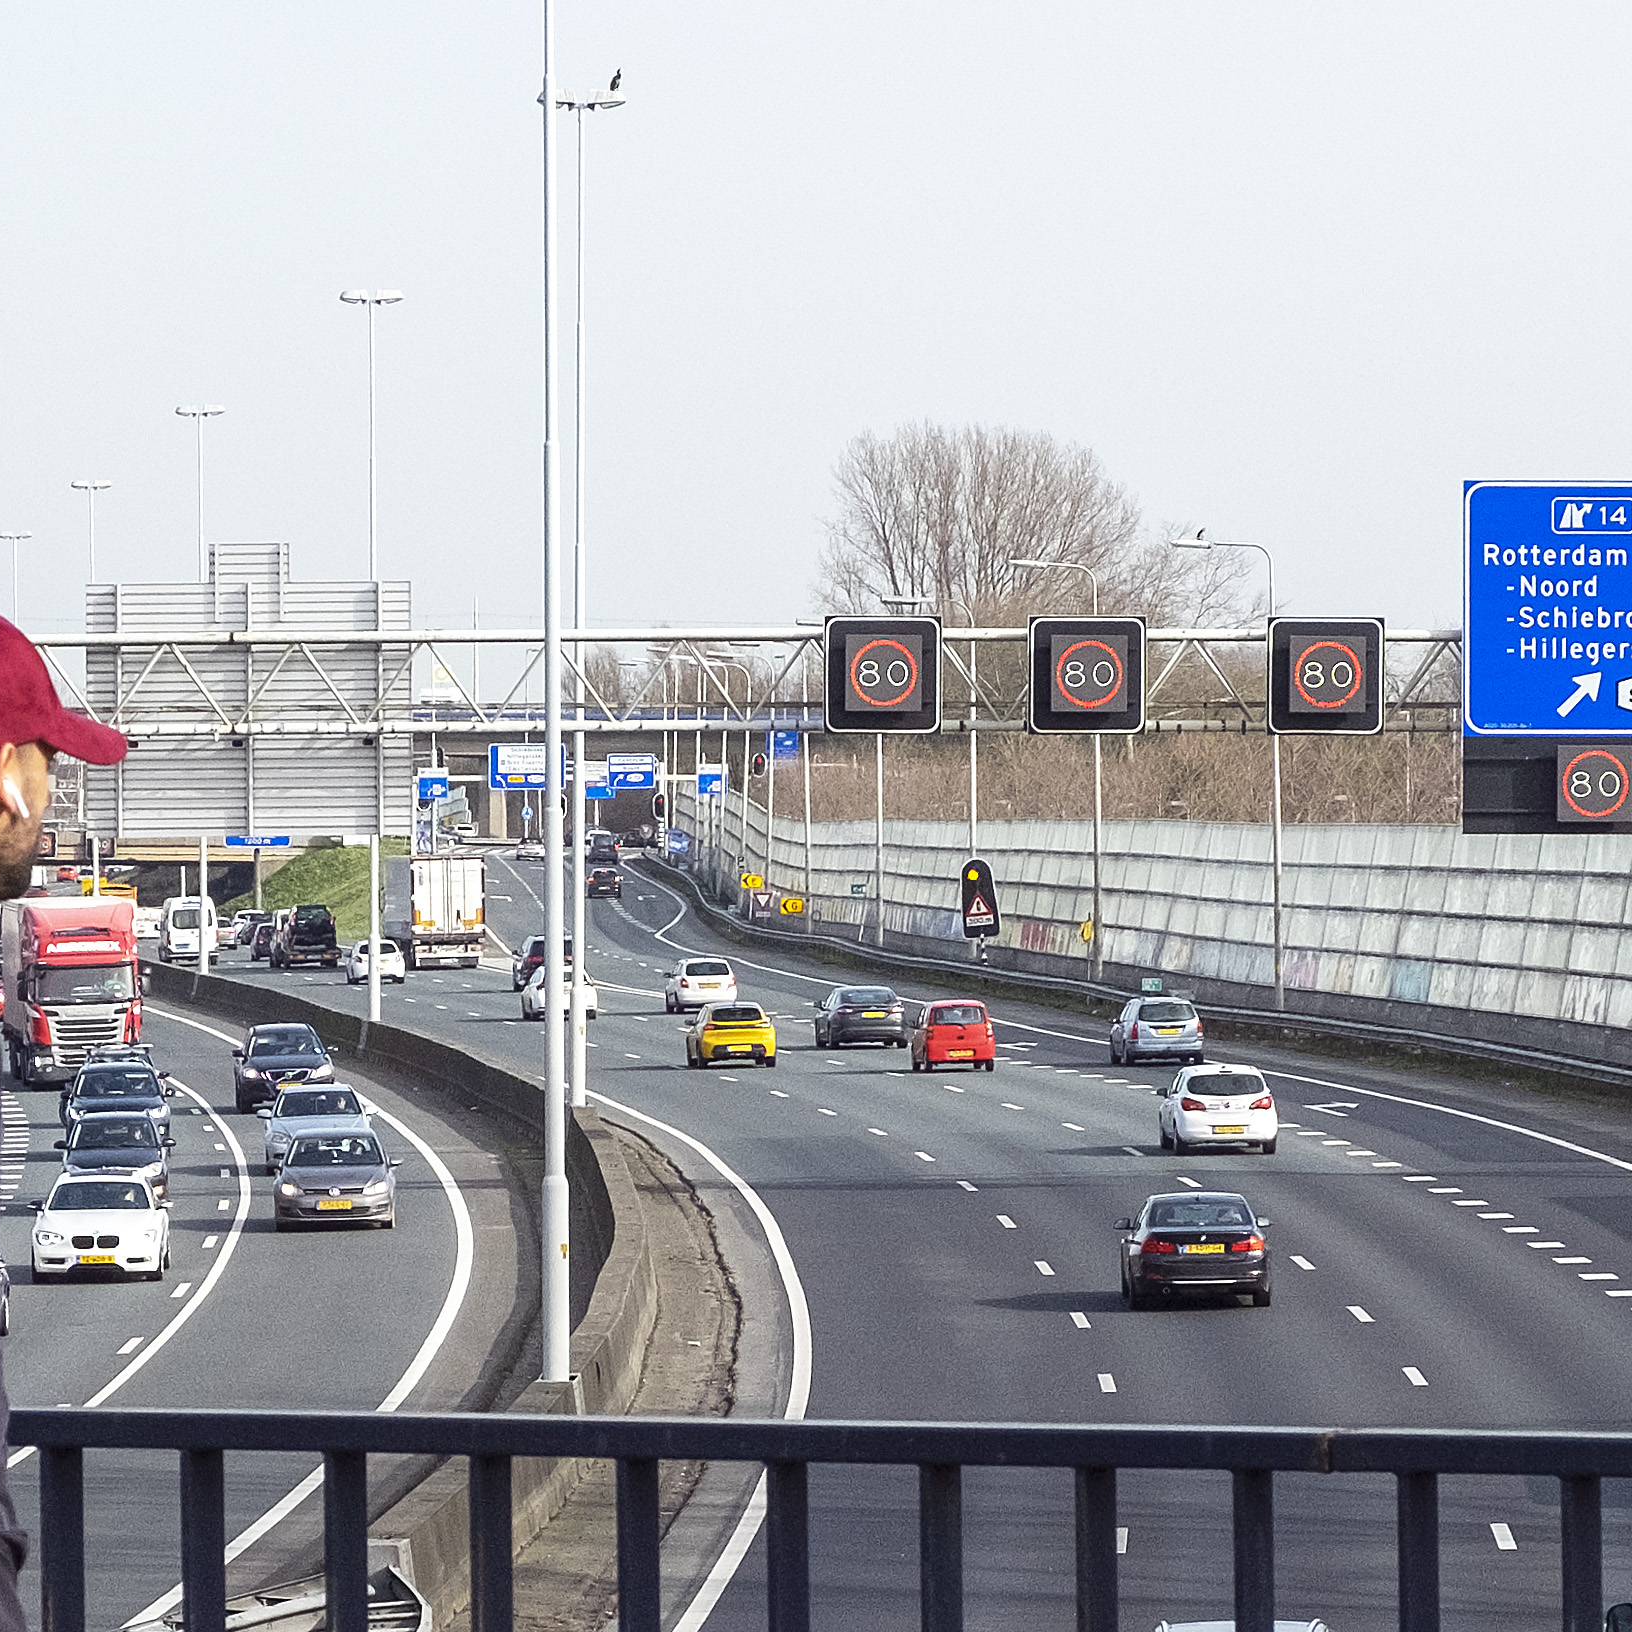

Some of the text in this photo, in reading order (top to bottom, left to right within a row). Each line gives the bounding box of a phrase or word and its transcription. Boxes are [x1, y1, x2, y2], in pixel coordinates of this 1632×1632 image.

[1599, 506, 1627, 525] 14
[1483, 543, 1628, 566] Rotterdam
[1506, 575, 1598, 597] -Noord
[858, 660, 909, 688] 80
[1063, 660, 1114, 688] 80
[1302, 660, 1353, 689] 80
[1569, 771, 1621, 798] 80
